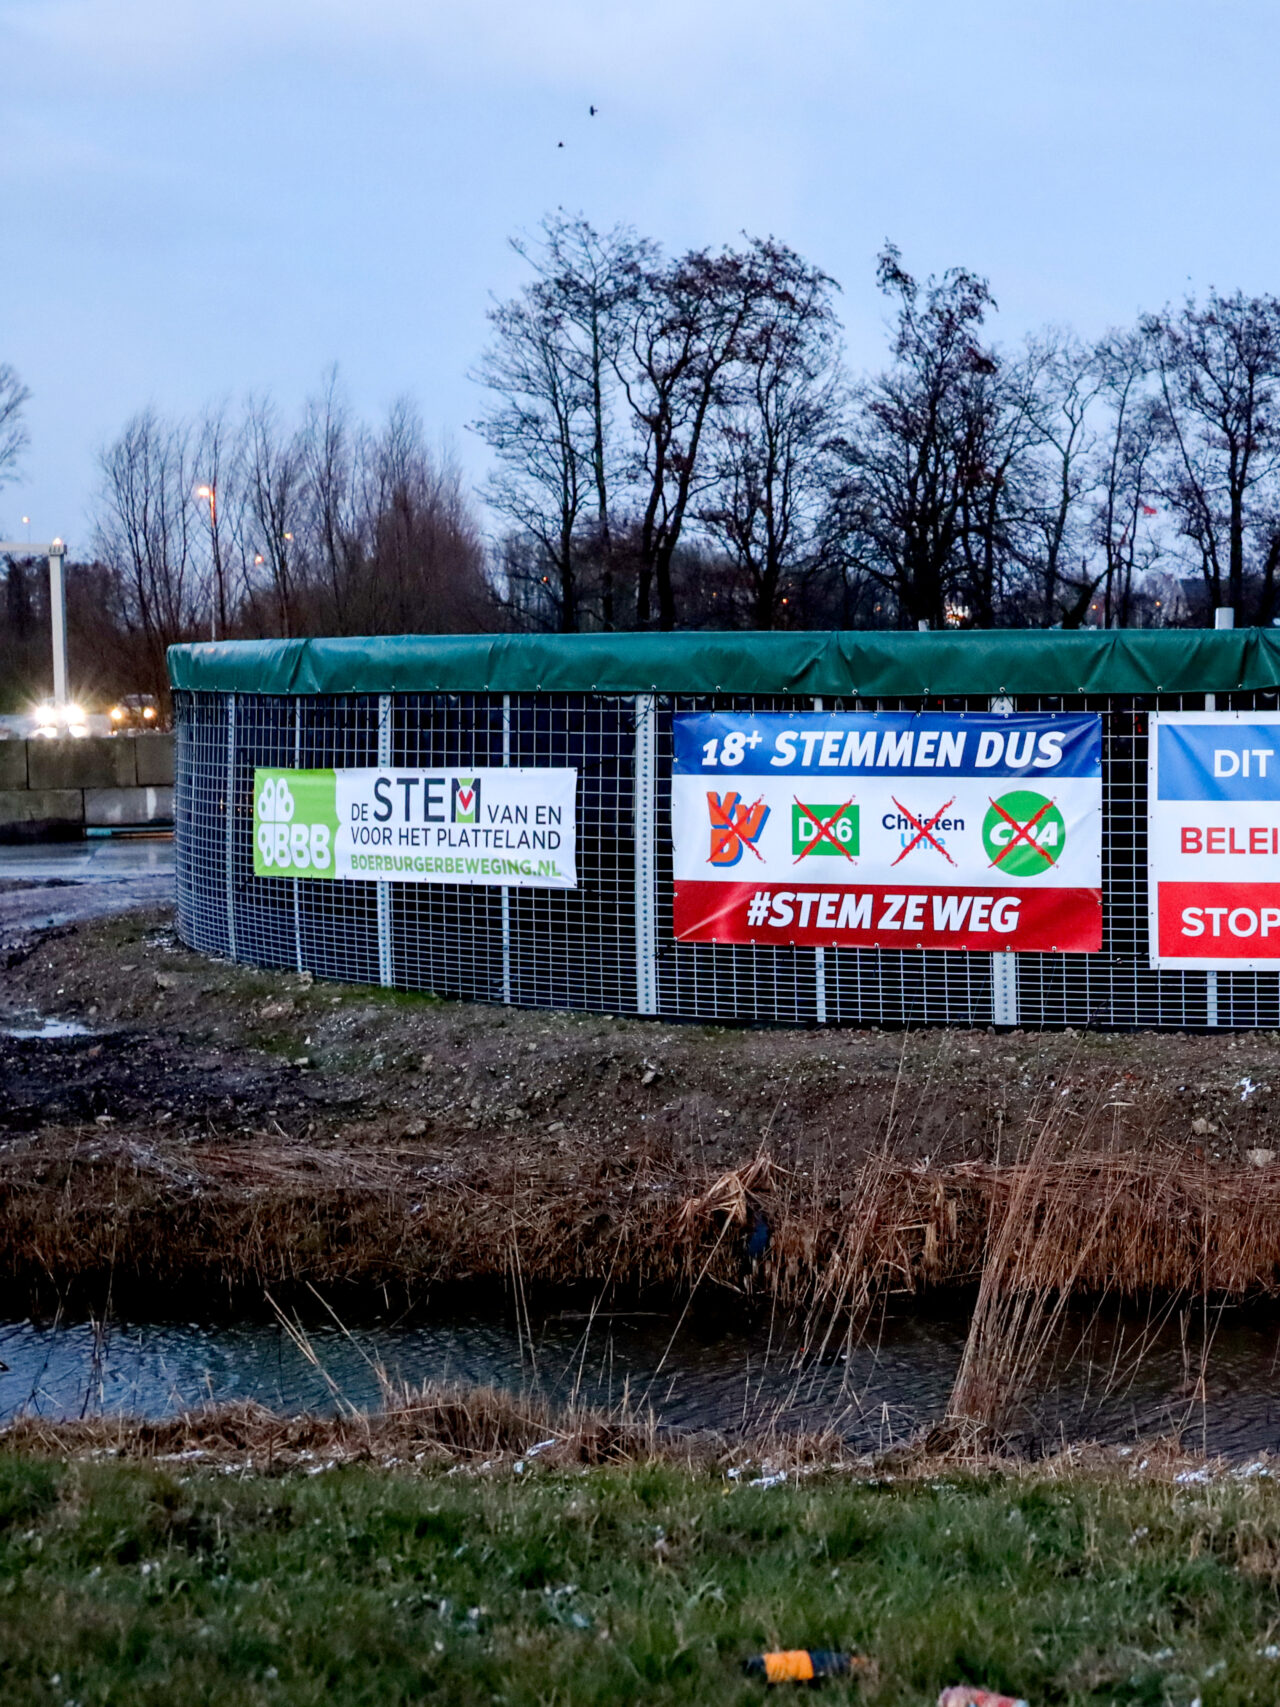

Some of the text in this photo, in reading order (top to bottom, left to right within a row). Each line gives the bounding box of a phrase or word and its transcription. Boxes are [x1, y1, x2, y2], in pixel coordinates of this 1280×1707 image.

[701, 729, 1066, 769] 18+ STEMMEN DUS
[1213, 749, 1274, 777] DIT
[351, 777, 562, 825] DE STEM VAN EN
[351, 826, 561, 850] VOOR HET PLATTELAND
[989, 821, 1058, 847] CDA
[351, 854, 561, 877] BOERBURGERBEWEGING.NL
[746, 891, 1022, 933] #STEM ZE WEG
